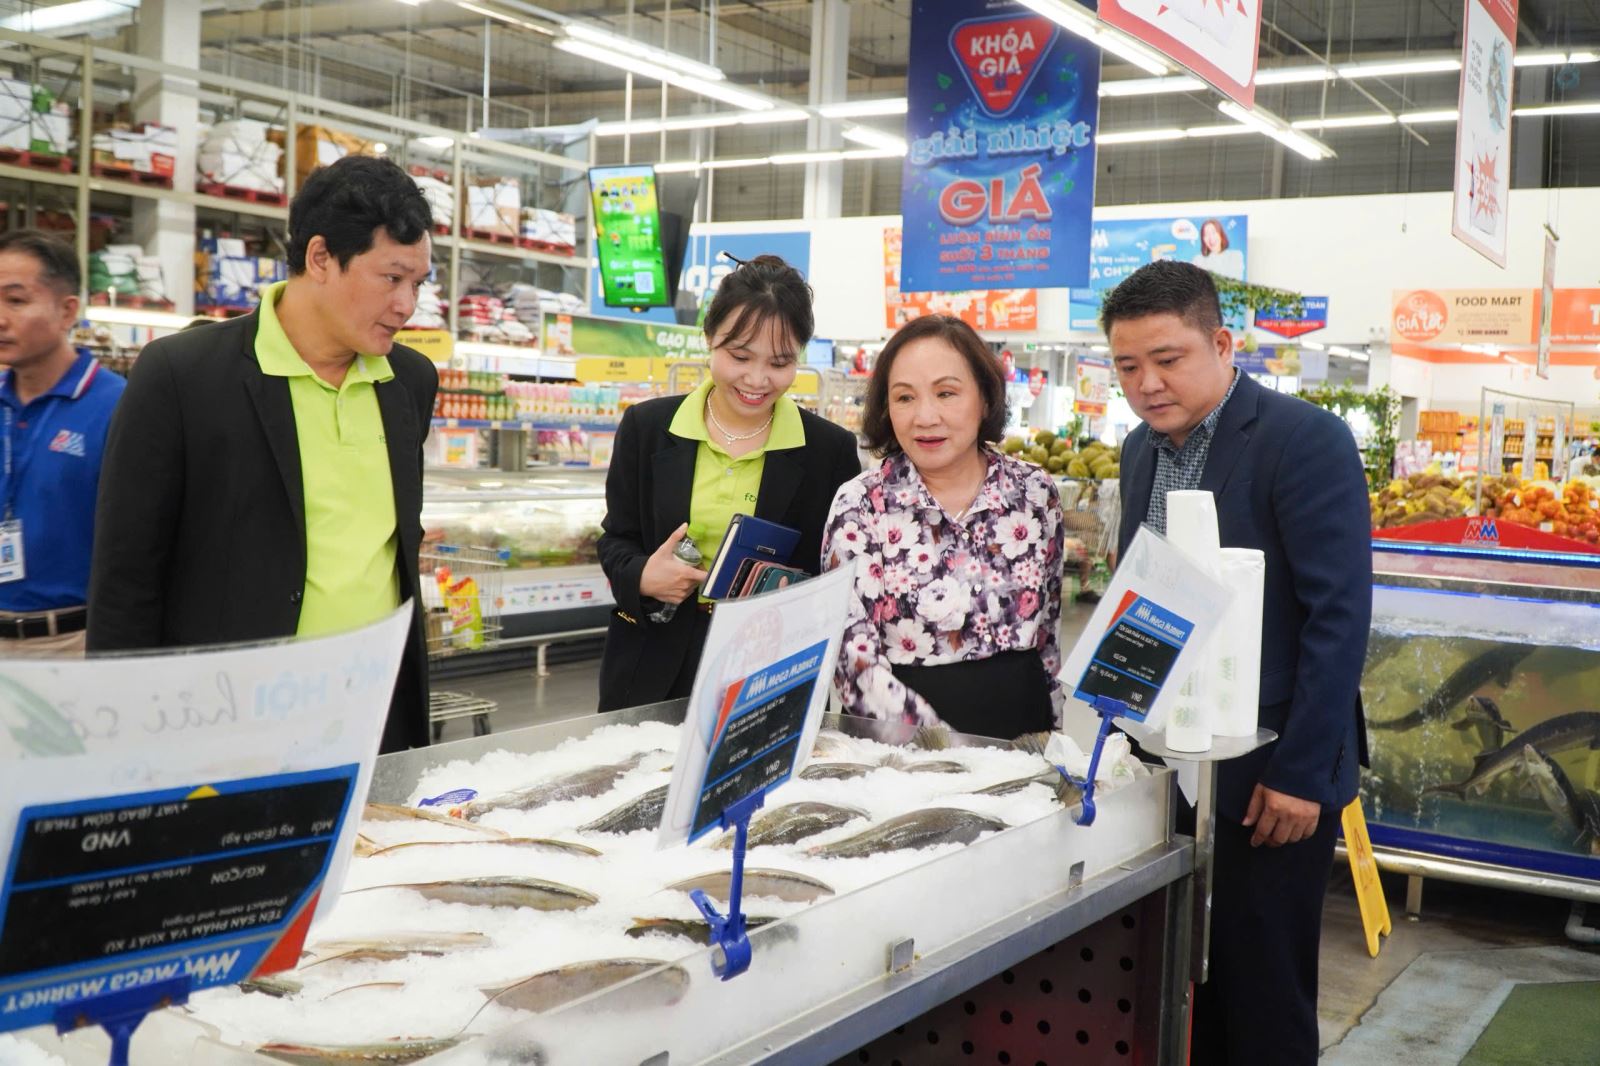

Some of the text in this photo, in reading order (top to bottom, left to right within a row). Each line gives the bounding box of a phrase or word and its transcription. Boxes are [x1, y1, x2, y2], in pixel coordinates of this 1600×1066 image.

[970, 27, 1035, 56] KHÓA
[911, 120, 1091, 165] giải nhiệt
[939, 163, 1052, 225] GIÁ
[980, 245, 993, 261] 3
[1456, 296, 1521, 306] FOOD MART
[656, 331, 685, 350] GẠO
[1149, 615, 1165, 628] Mega
[767, 669, 789, 687] Mega
[789, 656, 819, 677] Market
[243, 826, 278, 845] (Each
[311, 819, 333, 833] MỖI
[221, 831, 241, 847] kg)
[229, 912, 256, 930] SẢN
[258, 909, 282, 922] TÊN
[169, 929, 188, 942] VÀ
[191, 918, 228, 938] PHẨM
[129, 931, 166, 950] XUẤT
[109, 962, 180, 992] Mega
[5, 976, 106, 1009] Market
